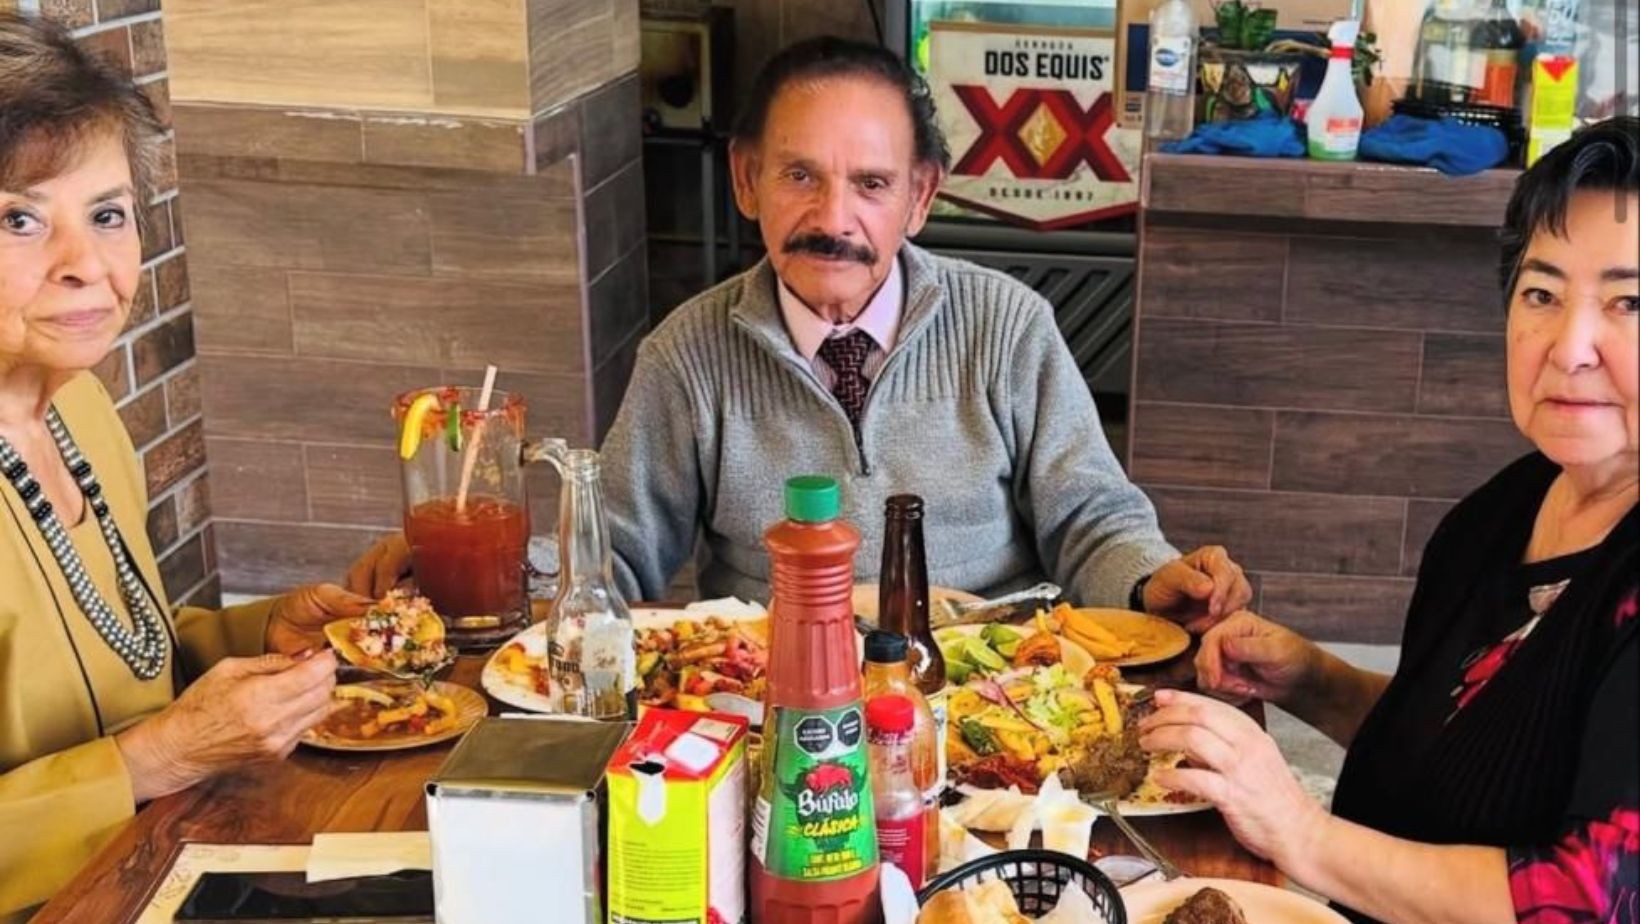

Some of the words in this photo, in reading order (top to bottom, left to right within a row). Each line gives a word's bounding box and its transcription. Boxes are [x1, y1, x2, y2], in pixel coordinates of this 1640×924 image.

[984, 51, 1029, 77] DOS
[1036, 53, 1104, 80] EQUIS
[950, 84, 1132, 182] XX
[798, 788, 859, 816] Búfalo
